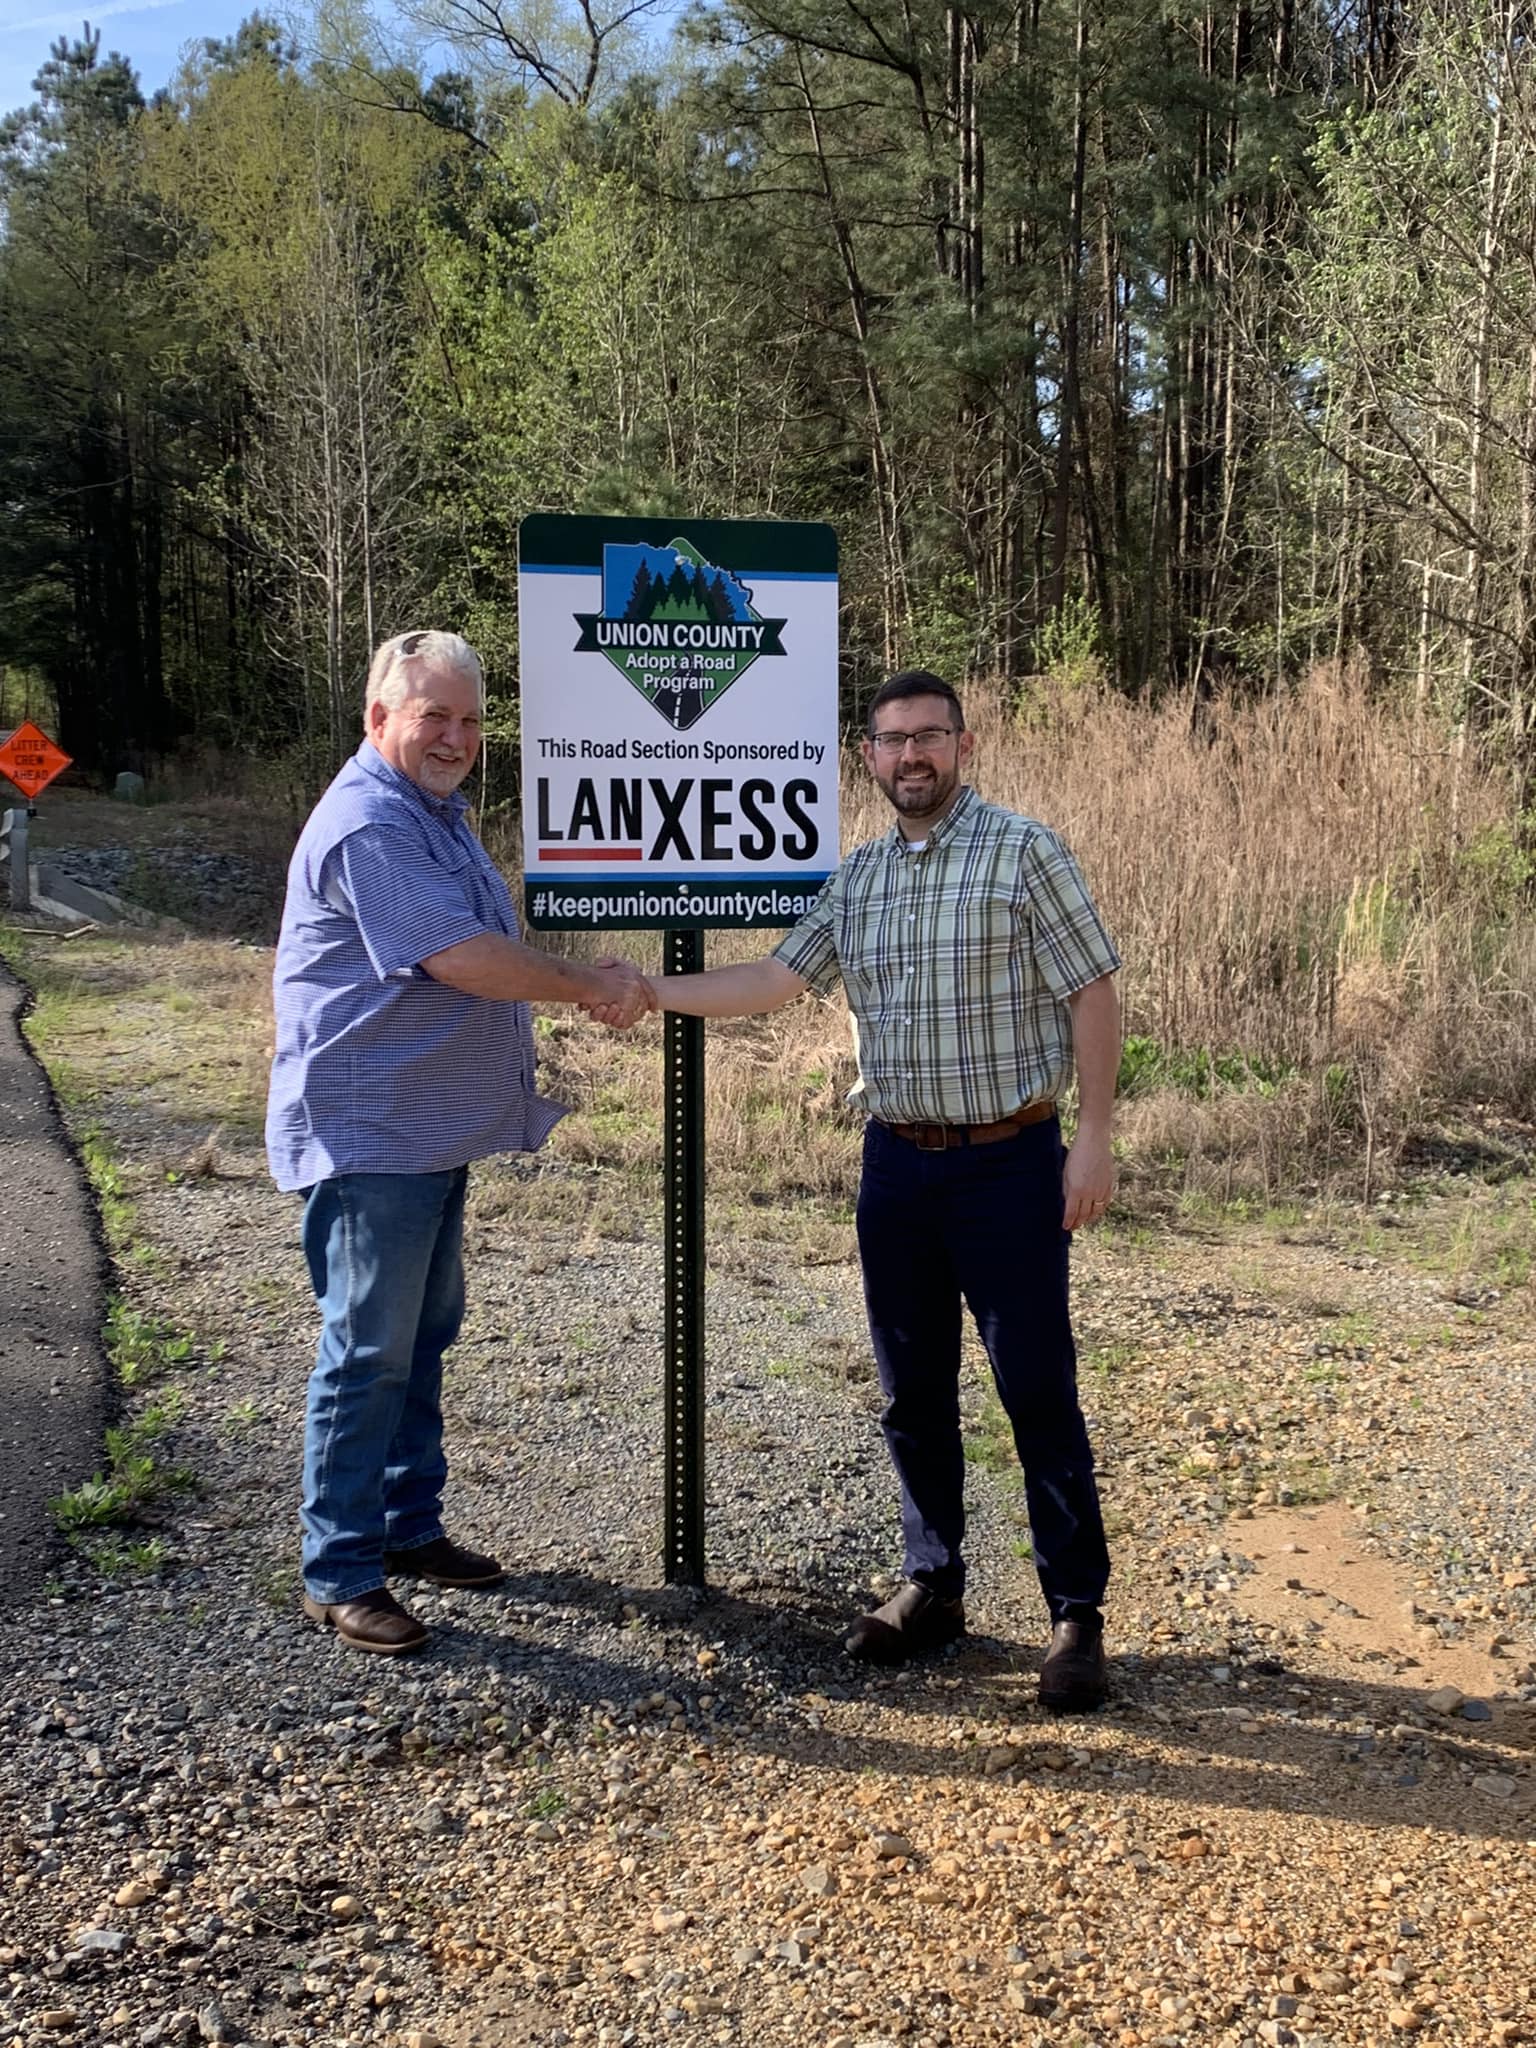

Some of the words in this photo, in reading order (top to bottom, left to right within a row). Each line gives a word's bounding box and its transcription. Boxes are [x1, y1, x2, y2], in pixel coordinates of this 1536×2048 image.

[596, 623, 668, 647] UNION
[673, 624, 765, 649] COUNTY
[625, 652, 677, 671] Adopt
[679, 657, 690, 670] a
[693, 654, 736, 670] Road
[643, 674, 715, 692] Program
[11, 740, 47, 751] LITTER
[537, 738, 577, 759] This
[581, 739, 627, 760] Road
[631, 739, 699, 760] Section
[703, 740, 800, 764] Sponsored
[803, 741, 825, 765] by
[15, 755, 44, 766] CREW
[13, 770, 48, 780] AHEAD
[538, 778, 819, 861] LANXESS
